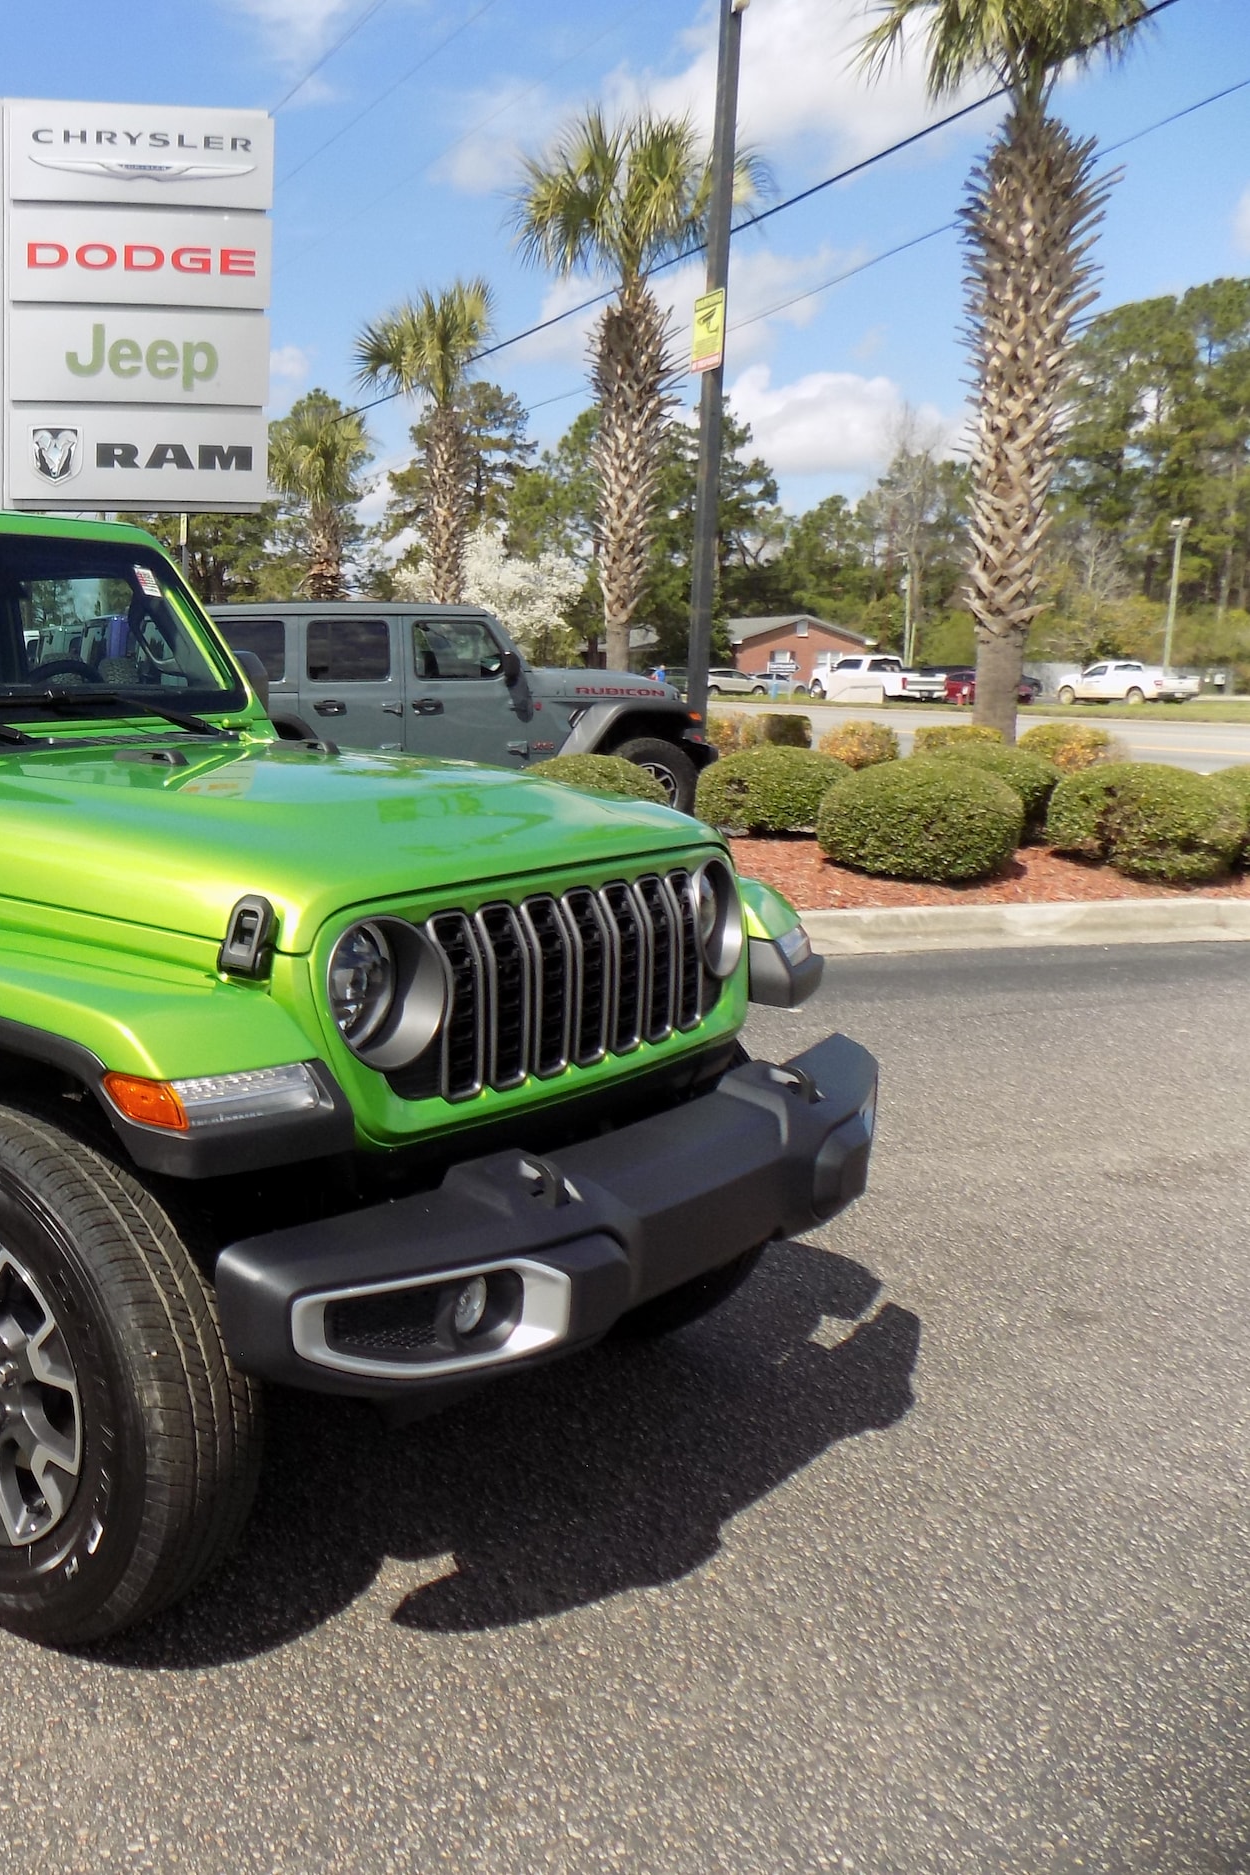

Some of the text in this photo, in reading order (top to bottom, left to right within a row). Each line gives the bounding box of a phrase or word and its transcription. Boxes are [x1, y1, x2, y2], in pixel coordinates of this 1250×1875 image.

[31, 128, 252, 152] CHRYSLER
[27, 242, 256, 277] DODGE
[65, 323, 218, 391] Jeep
[96, 442, 253, 472] RAM
[575, 687, 665, 697] RUBICON
